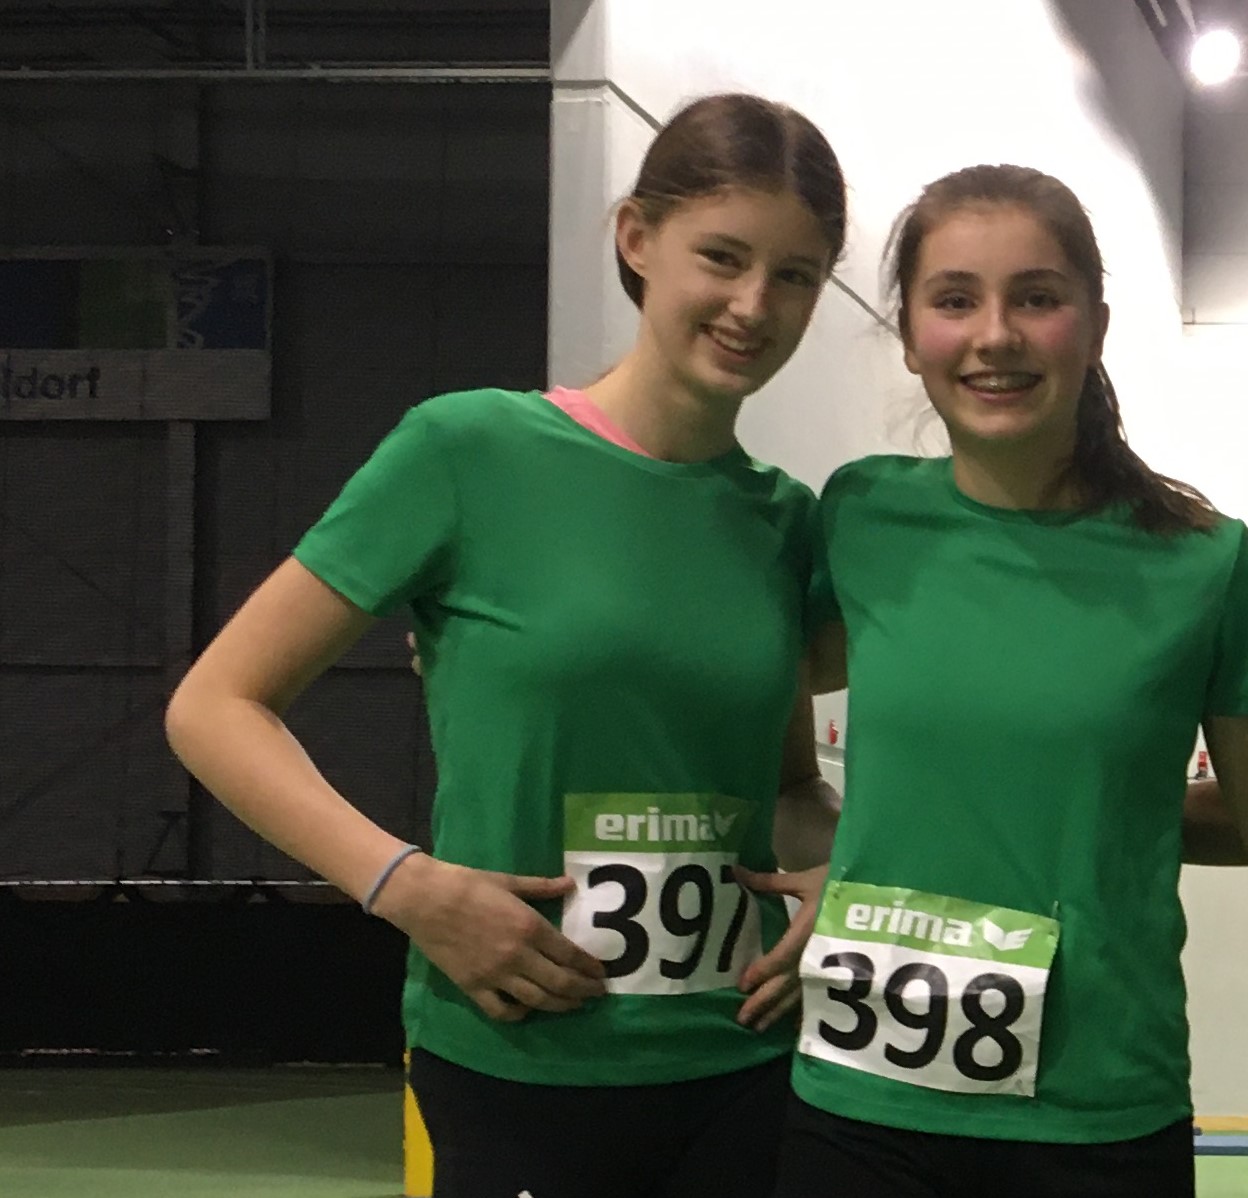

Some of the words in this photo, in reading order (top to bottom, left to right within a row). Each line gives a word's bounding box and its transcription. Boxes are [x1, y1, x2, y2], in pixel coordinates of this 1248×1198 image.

[587, 863, 749, 979] 397
[845, 899, 973, 948] erima
[818, 951, 1026, 1082] 398
